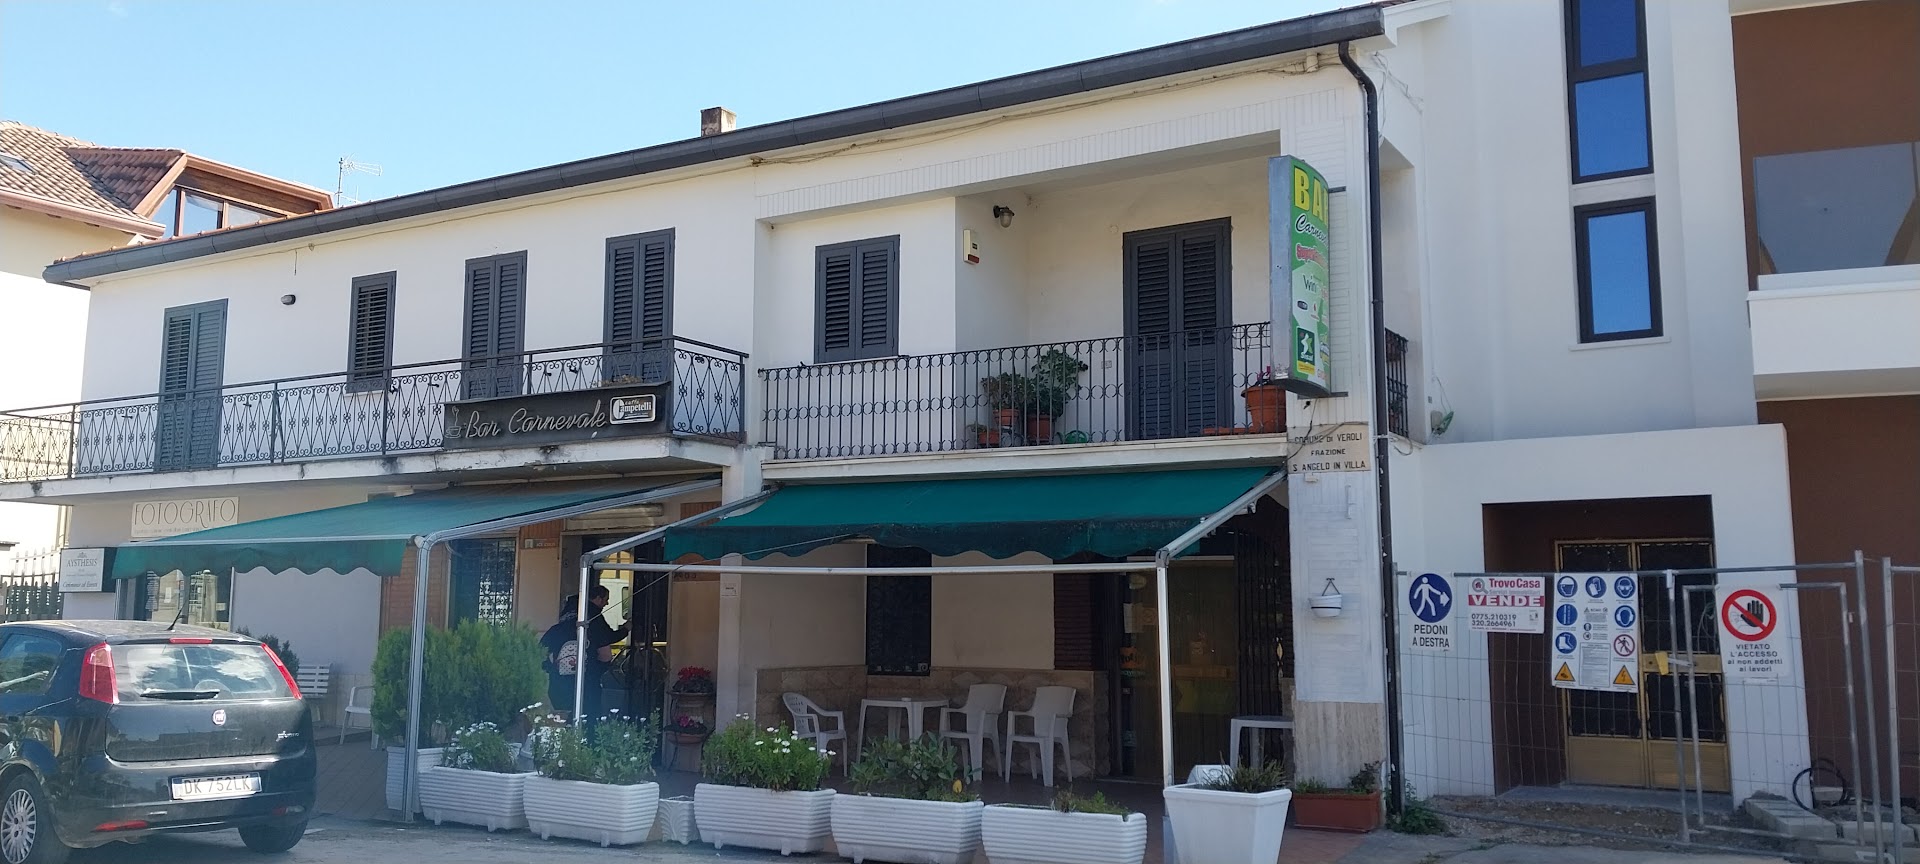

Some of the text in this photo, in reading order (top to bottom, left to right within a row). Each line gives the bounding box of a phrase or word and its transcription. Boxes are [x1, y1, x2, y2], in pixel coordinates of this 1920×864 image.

[465, 400, 607, 439] Bar Carnevale
[1336, 432, 1363, 442] VEROLI
[1310, 448, 1346, 456] FRAZIONE
[1302, 462, 1330, 471] ANGELO
[1333, 461, 1341, 470] IN
[1344, 460, 1366, 469] VILLA
[134, 499, 236, 528] FOTOGRAFO
[1471, 595, 1541, 607] VENDE
[1414, 624, 1448, 635] PEDONI
[1412, 637, 1450, 647] A DESTRA
[184, 775, 250, 794] DK 752LK
